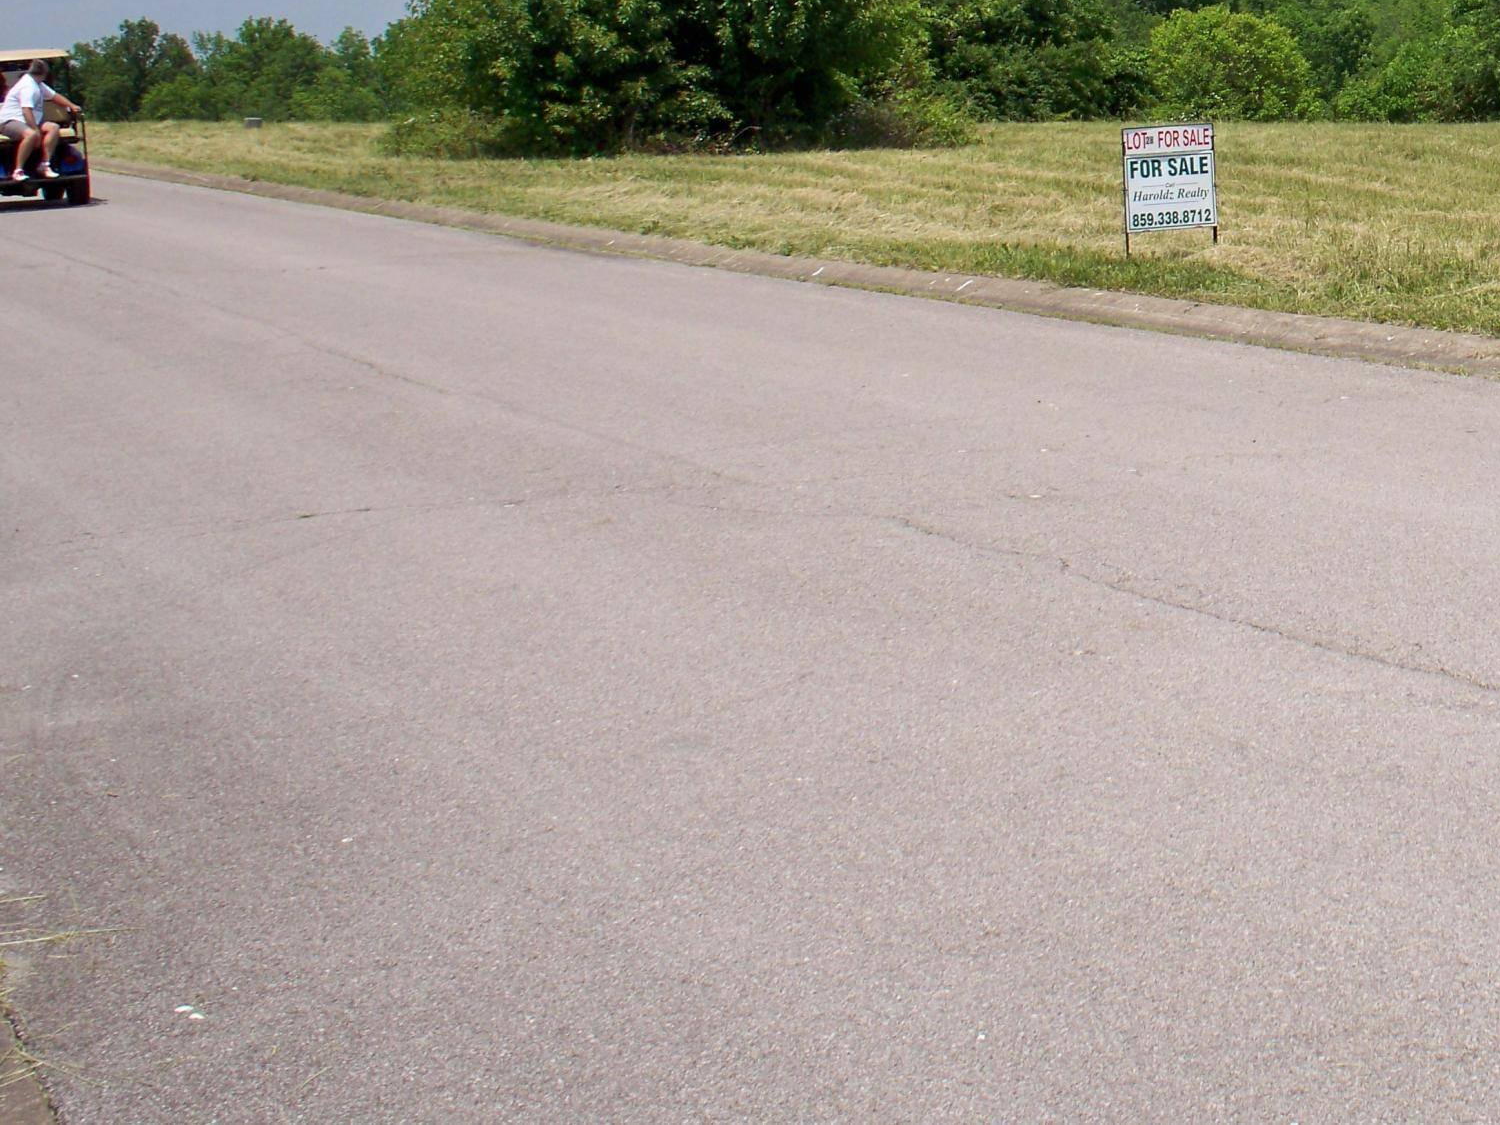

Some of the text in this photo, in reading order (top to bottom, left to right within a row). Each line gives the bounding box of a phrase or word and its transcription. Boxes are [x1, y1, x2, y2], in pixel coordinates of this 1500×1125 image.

[1126, 132, 1147, 149] LOT
[1158, 130, 1180, 148] FOR
[1183, 128, 1209, 146] SALE
[1130, 156, 1209, 179] FOR SALE
[1133, 187, 1210, 202] Haroldz Realty
[1132, 208, 1212, 227] 859.338.8712
